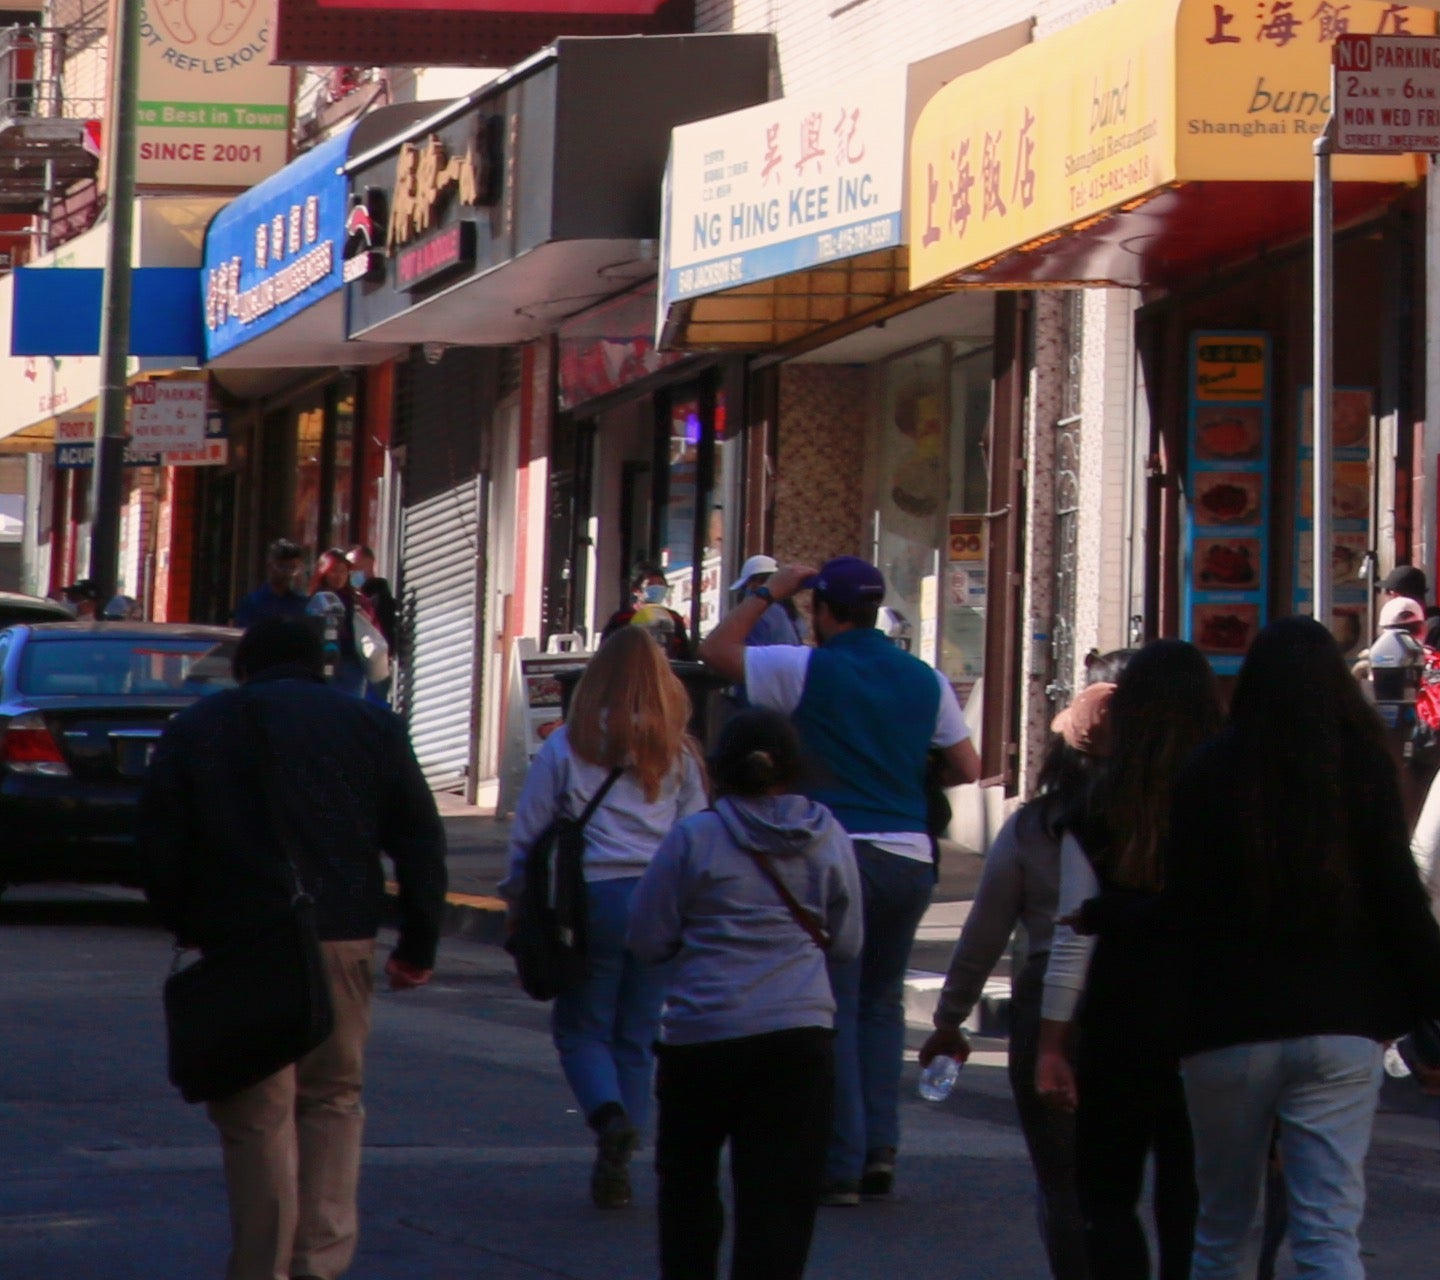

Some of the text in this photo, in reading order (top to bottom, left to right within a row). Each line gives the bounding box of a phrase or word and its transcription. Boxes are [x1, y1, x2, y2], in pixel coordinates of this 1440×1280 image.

[1339, 40, 1370, 68] NO
[163, 106, 205, 124] Best
[211, 107, 229, 125] in
[234, 108, 284, 126] Town
[1344, 108, 1440, 128] MON WED FRI
[1188, 118, 1287, 138] Shanghai
[1345, 134, 1381, 147] STREET
[140, 142, 262, 163] SINCE 2001
[922, 106, 1035, 249] 上海飯店
[692, 173, 879, 252] NG HING KEE INC.
